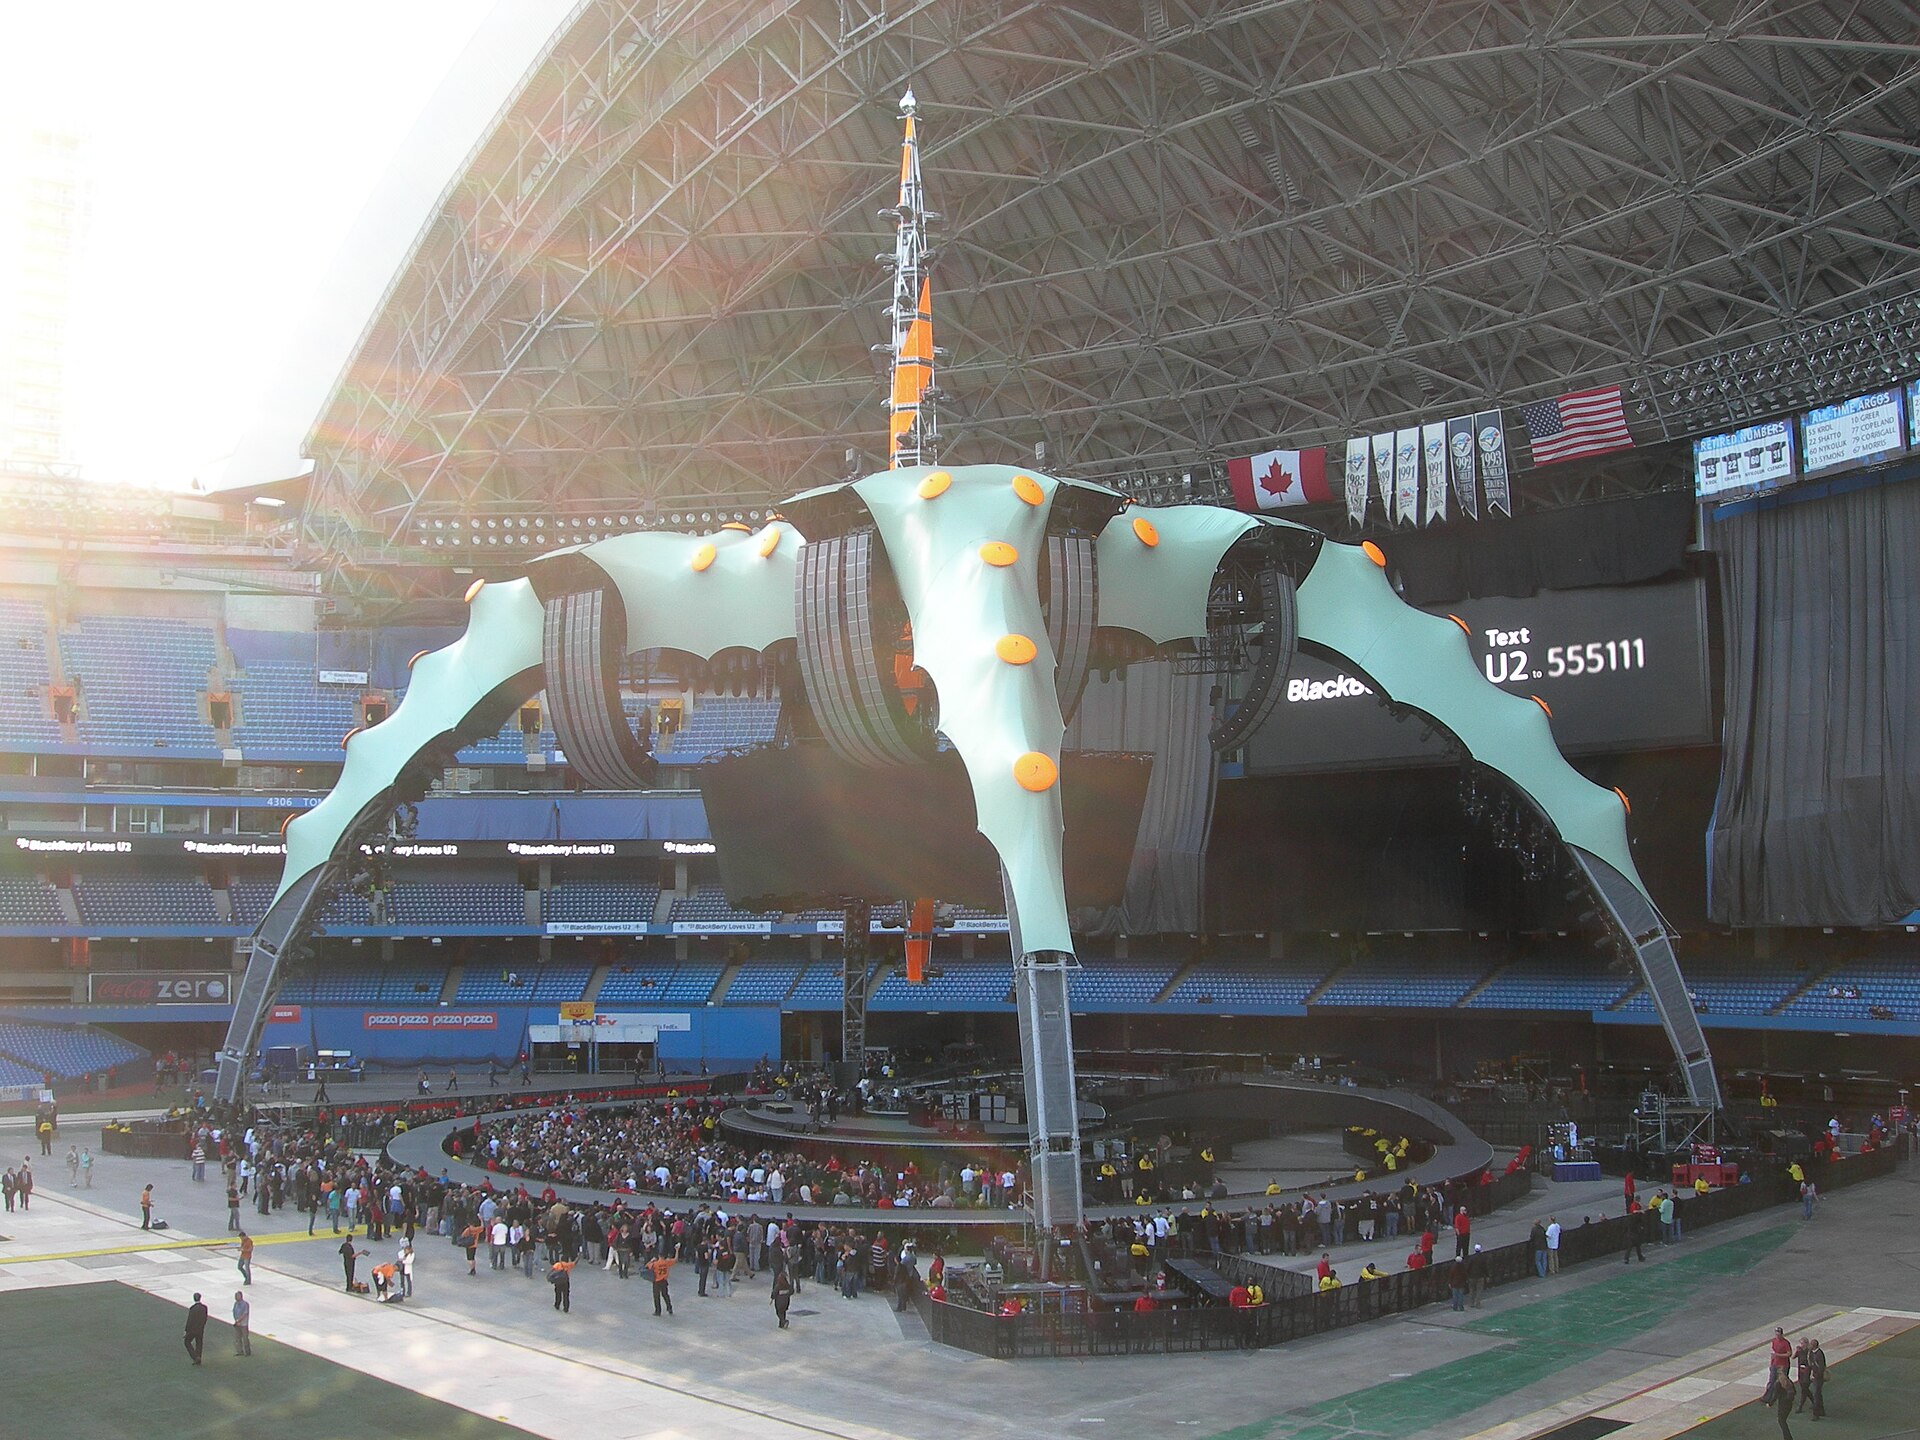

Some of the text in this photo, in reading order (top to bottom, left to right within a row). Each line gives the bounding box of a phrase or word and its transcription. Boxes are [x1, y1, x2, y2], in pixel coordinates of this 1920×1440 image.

[1857, 392, 1890, 411] ARGOS
[1860, 410, 1880, 422] GREER
[1817, 424, 1833, 434] KROL
[1851, 416, 1895, 434] 77 COPELAND
[1700, 421, 1785, 452] RETIRED NUMBERS
[1808, 431, 1842, 446] 22 SHATTO
[1861, 428, 1896, 442] CORRIGALL
[1809, 447, 1818, 456] 60
[1861, 438, 1887, 452] MORRIS
[1456, 456, 1472, 470] 992
[1480, 450, 1503, 467] 1993
[1819, 450, 1845, 463] SYMONS
[1728, 460, 1737, 470] 22
[1398, 465, 1415, 480] 1991
[1346, 473, 1366, 486] 1985
[1485, 627, 1530, 647] Text
[1485, 637, 1645, 684] U2 to 555111
[1286, 674, 1374, 702] BlackB
[267, 797, 292, 806] 4306
[29, 839, 132, 853] BlackBerry Loves U2
[196, 842, 251, 855] BlackBerry
[251, 843, 281, 854] Loves
[413, 844, 442, 855] Loves
[443, 844, 458, 855] U2
[519, 844, 615, 856] BlackBerry Loves U2
[569, 923, 602, 931] BlackBerry
[603, 923, 622, 931] Loves
[695, 923, 727, 931] BlackBerry
[966, 921, 998, 930] BlackBerry
[157, 979, 225, 998] zero
[368, 1015, 494, 1026] pizza pizza pizza pizza
